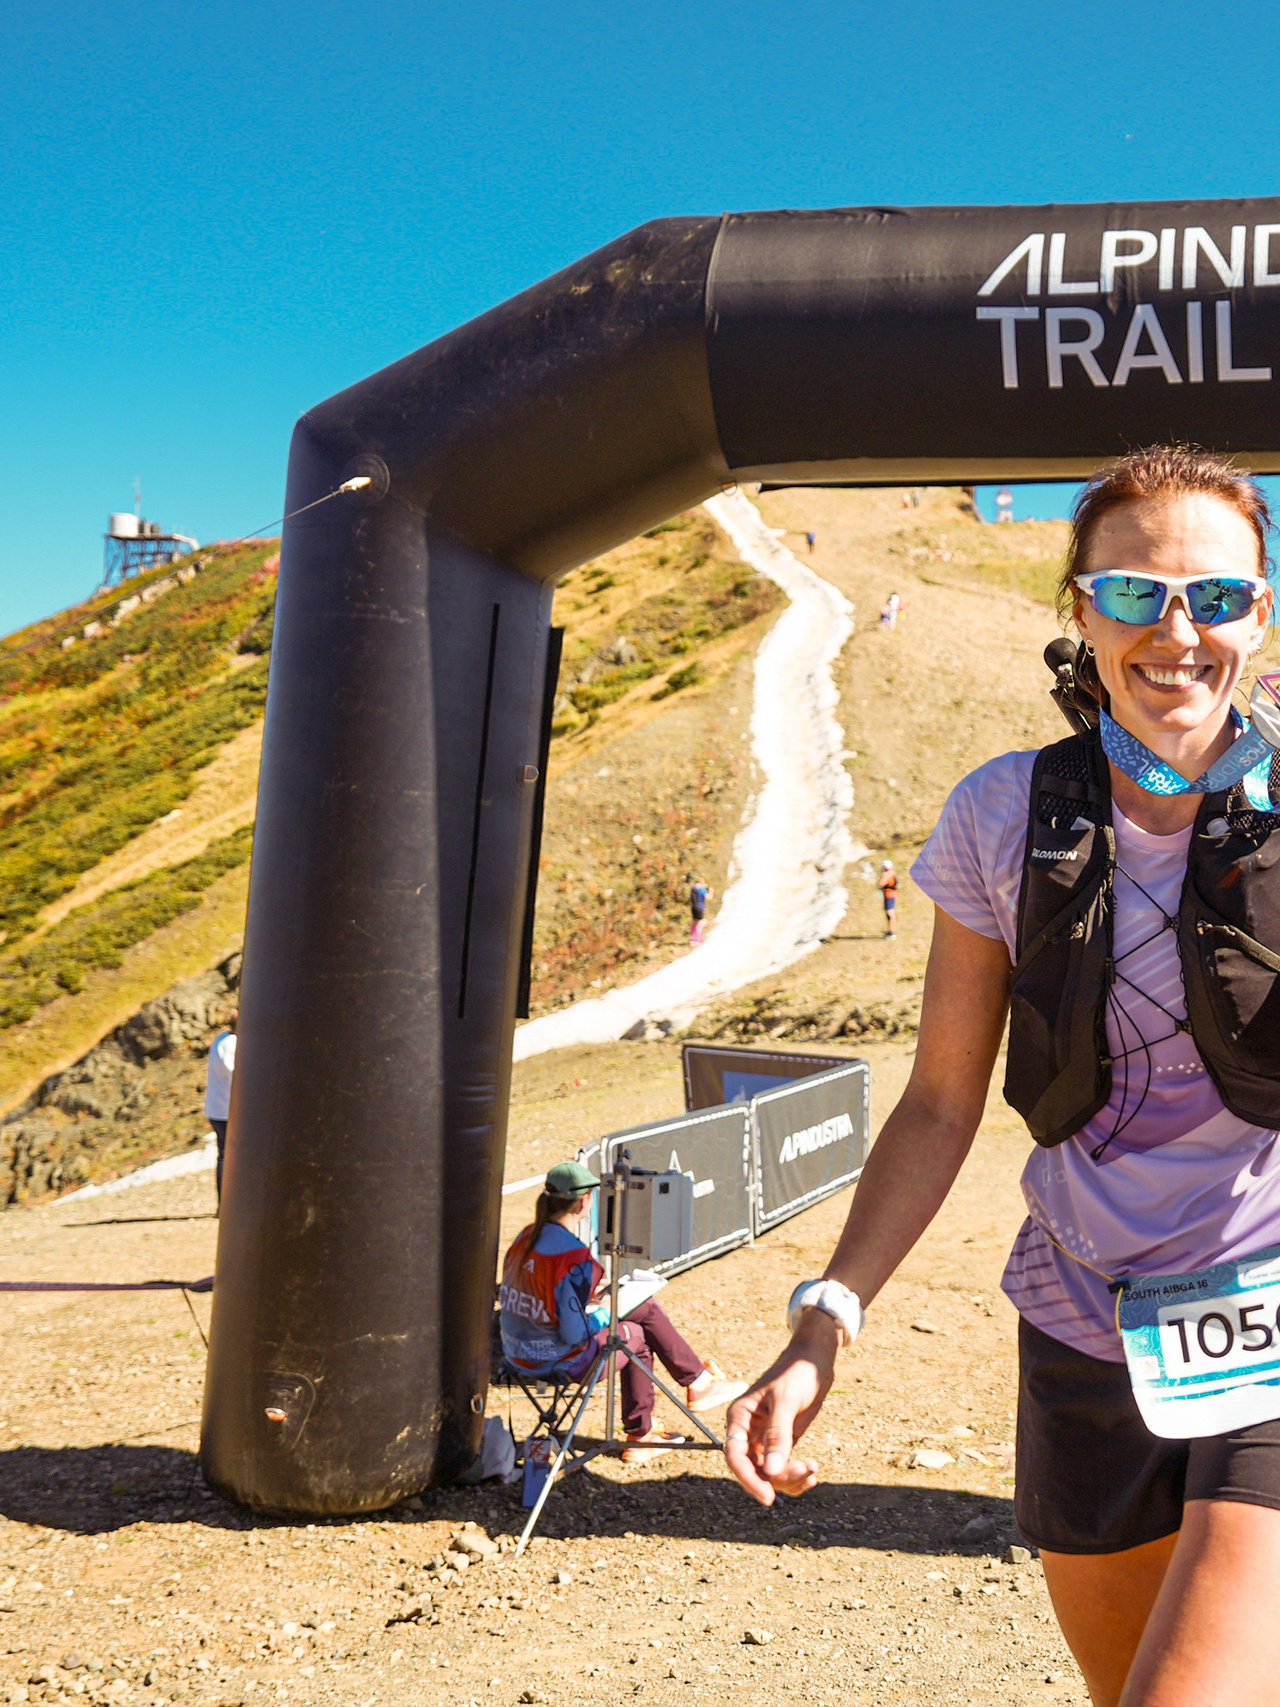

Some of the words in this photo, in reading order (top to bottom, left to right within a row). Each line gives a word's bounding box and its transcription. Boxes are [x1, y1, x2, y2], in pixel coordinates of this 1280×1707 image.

[976, 300, 1273, 389] TRAIL
[499, 1284, 551, 1323] CREW
[1123, 1288, 1160, 1302] SOUTH
[1163, 1281, 1196, 1295] AIBGA
[1197, 1279, 1209, 1289] 16
